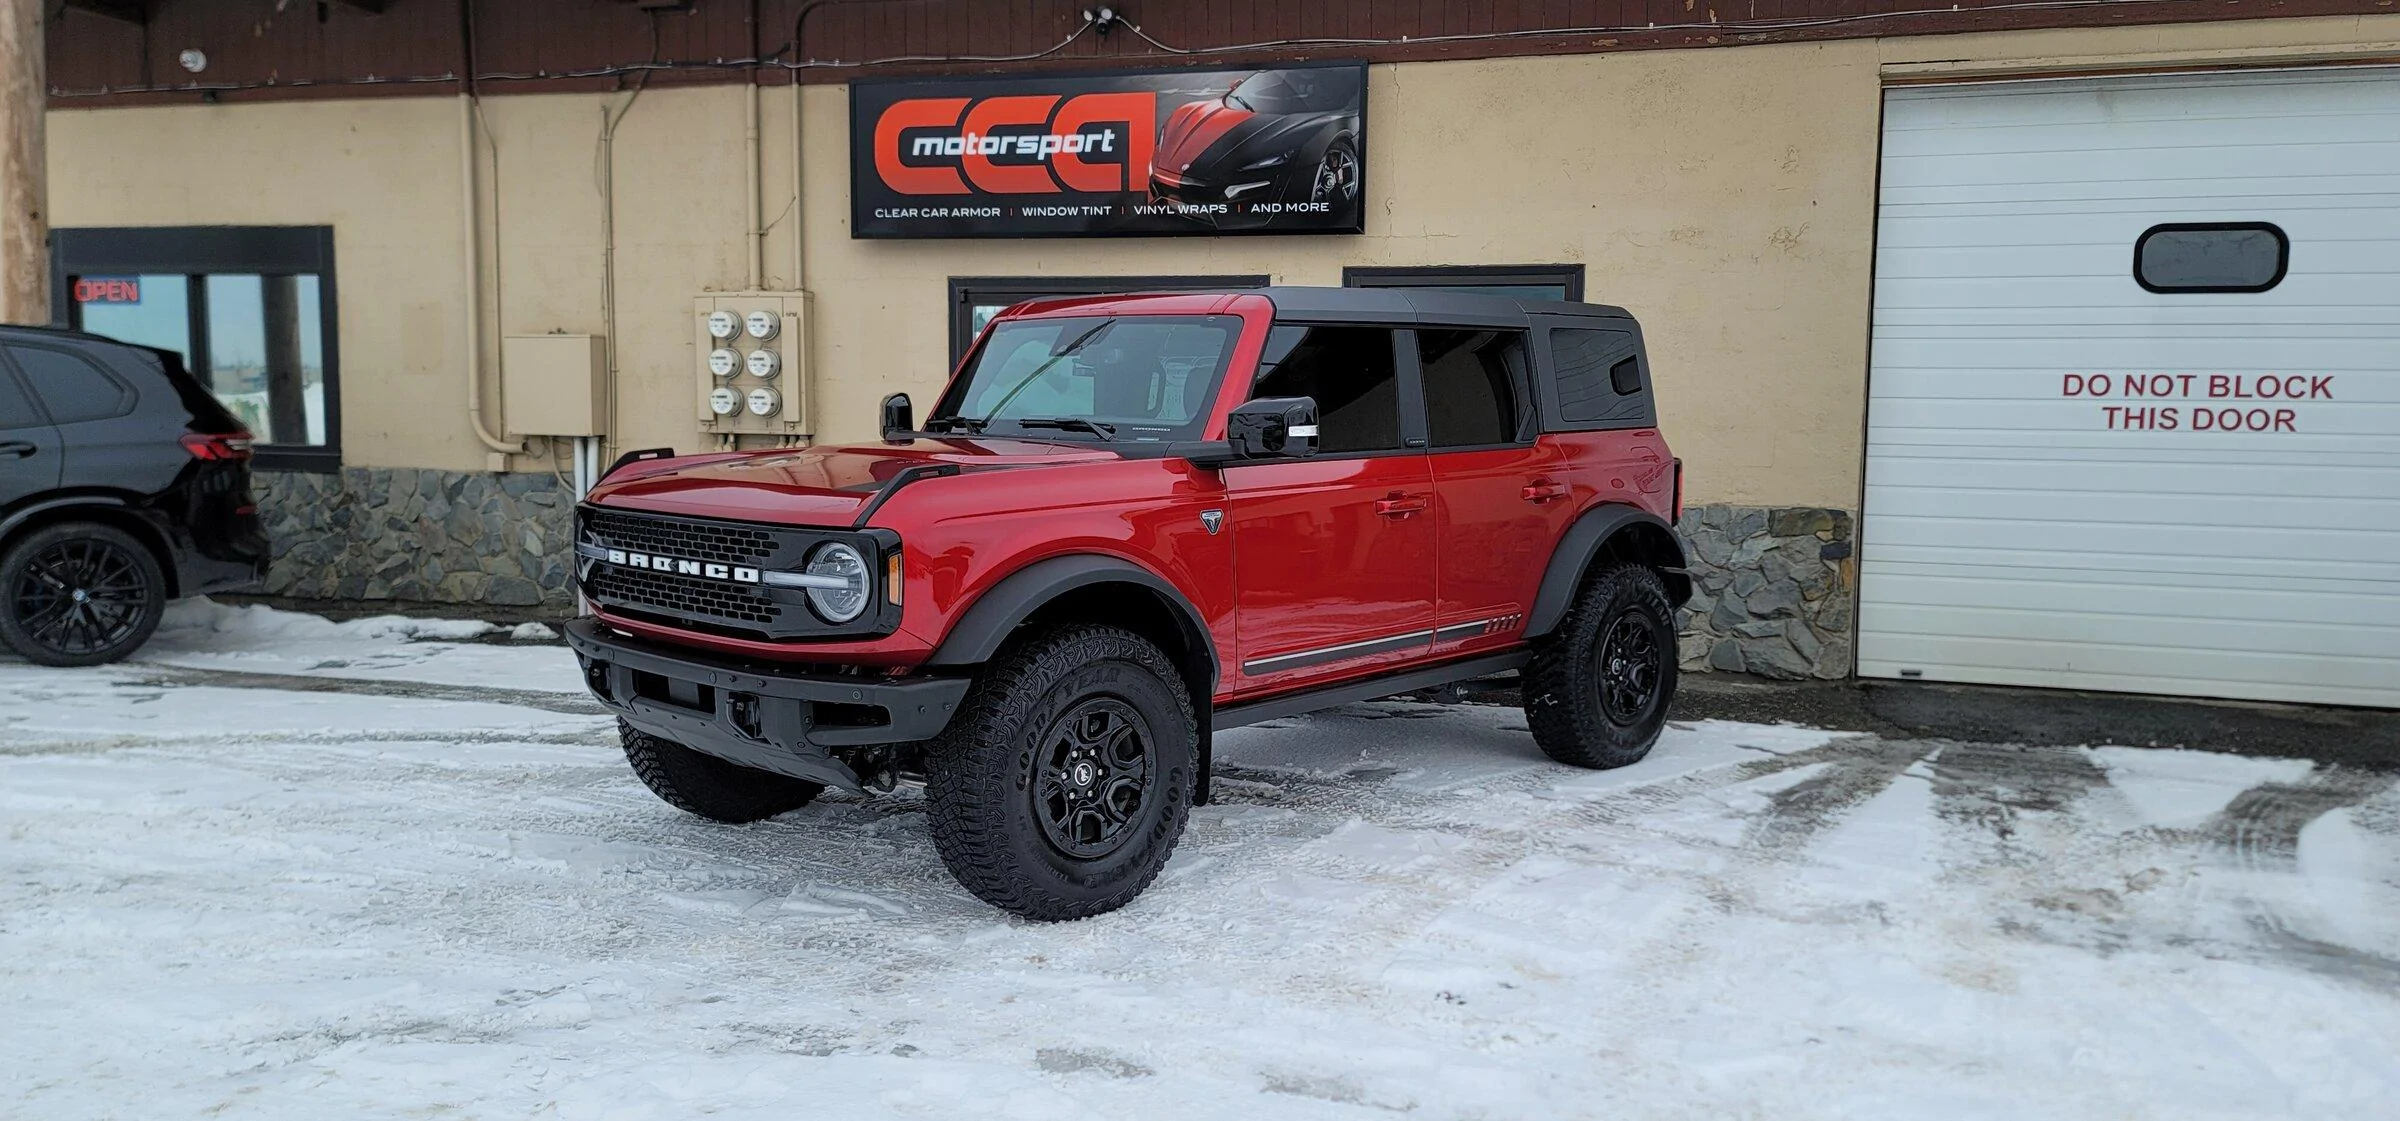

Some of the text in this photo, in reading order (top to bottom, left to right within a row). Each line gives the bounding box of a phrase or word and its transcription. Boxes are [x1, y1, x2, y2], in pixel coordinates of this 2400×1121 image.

[912, 129, 1116, 160] motorsport
[874, 202, 1330, 218] CLEAR CAR ARMOR WINDOW TINT VINYL WRAPS AND MORE
[74, 279, 138, 302] OPEN
[2062, 374, 2335, 399] DO NOT BLOCK
[2102, 407, 2297, 432] THIS DOOR
[608, 549, 759, 583] BRONCO
